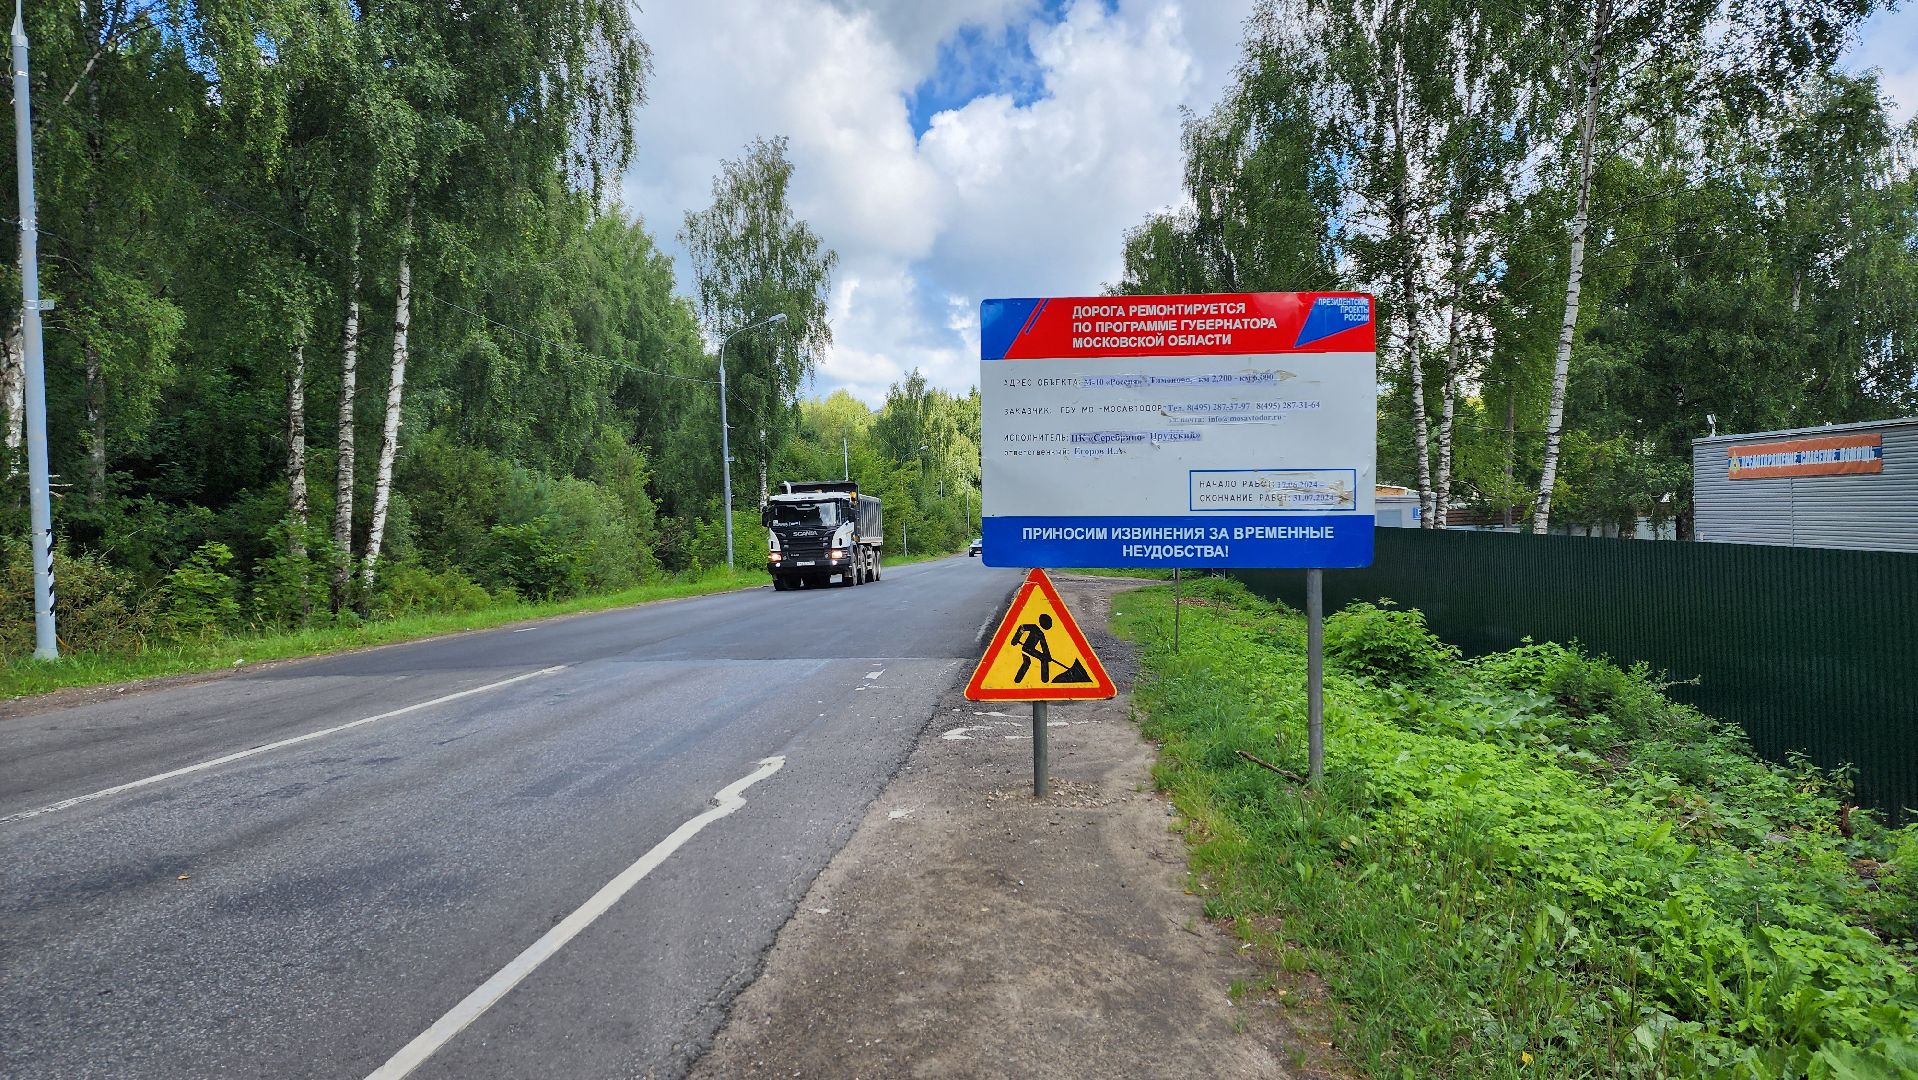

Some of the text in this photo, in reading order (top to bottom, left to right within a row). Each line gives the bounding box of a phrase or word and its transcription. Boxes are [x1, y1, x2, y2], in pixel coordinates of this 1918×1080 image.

[1318, 298, 1369, 306] ПРЕЗИДЕНТСКИЕ
[1072, 303, 1245, 319] ДОРОГА РЕМОНТИРУЕТСЯ
[1073, 318, 1277, 333] ПО ПРОГРАММЕ ГУБЕРНАТОРА
[1072, 332, 1231, 348] МОСКОВСКОЙ ОБЛАСТИ
[1213, 402, 1250, 411] 287-37-97
[1256, 402, 1281, 410] 8(495)
[1283, 401, 1320, 409] 287-31-64
[1200, 480, 1237, 488] НАЧАЛО
[1200, 493, 1253, 502] ОКОНЧАНИЕ
[1022, 526, 1334, 540] ПРИНОСИМ ИЗВИНЕНИЯ ЗА ВРЕМЕННЫЕ
[1122, 545, 1229, 559] НЕУДОБСТВА!
